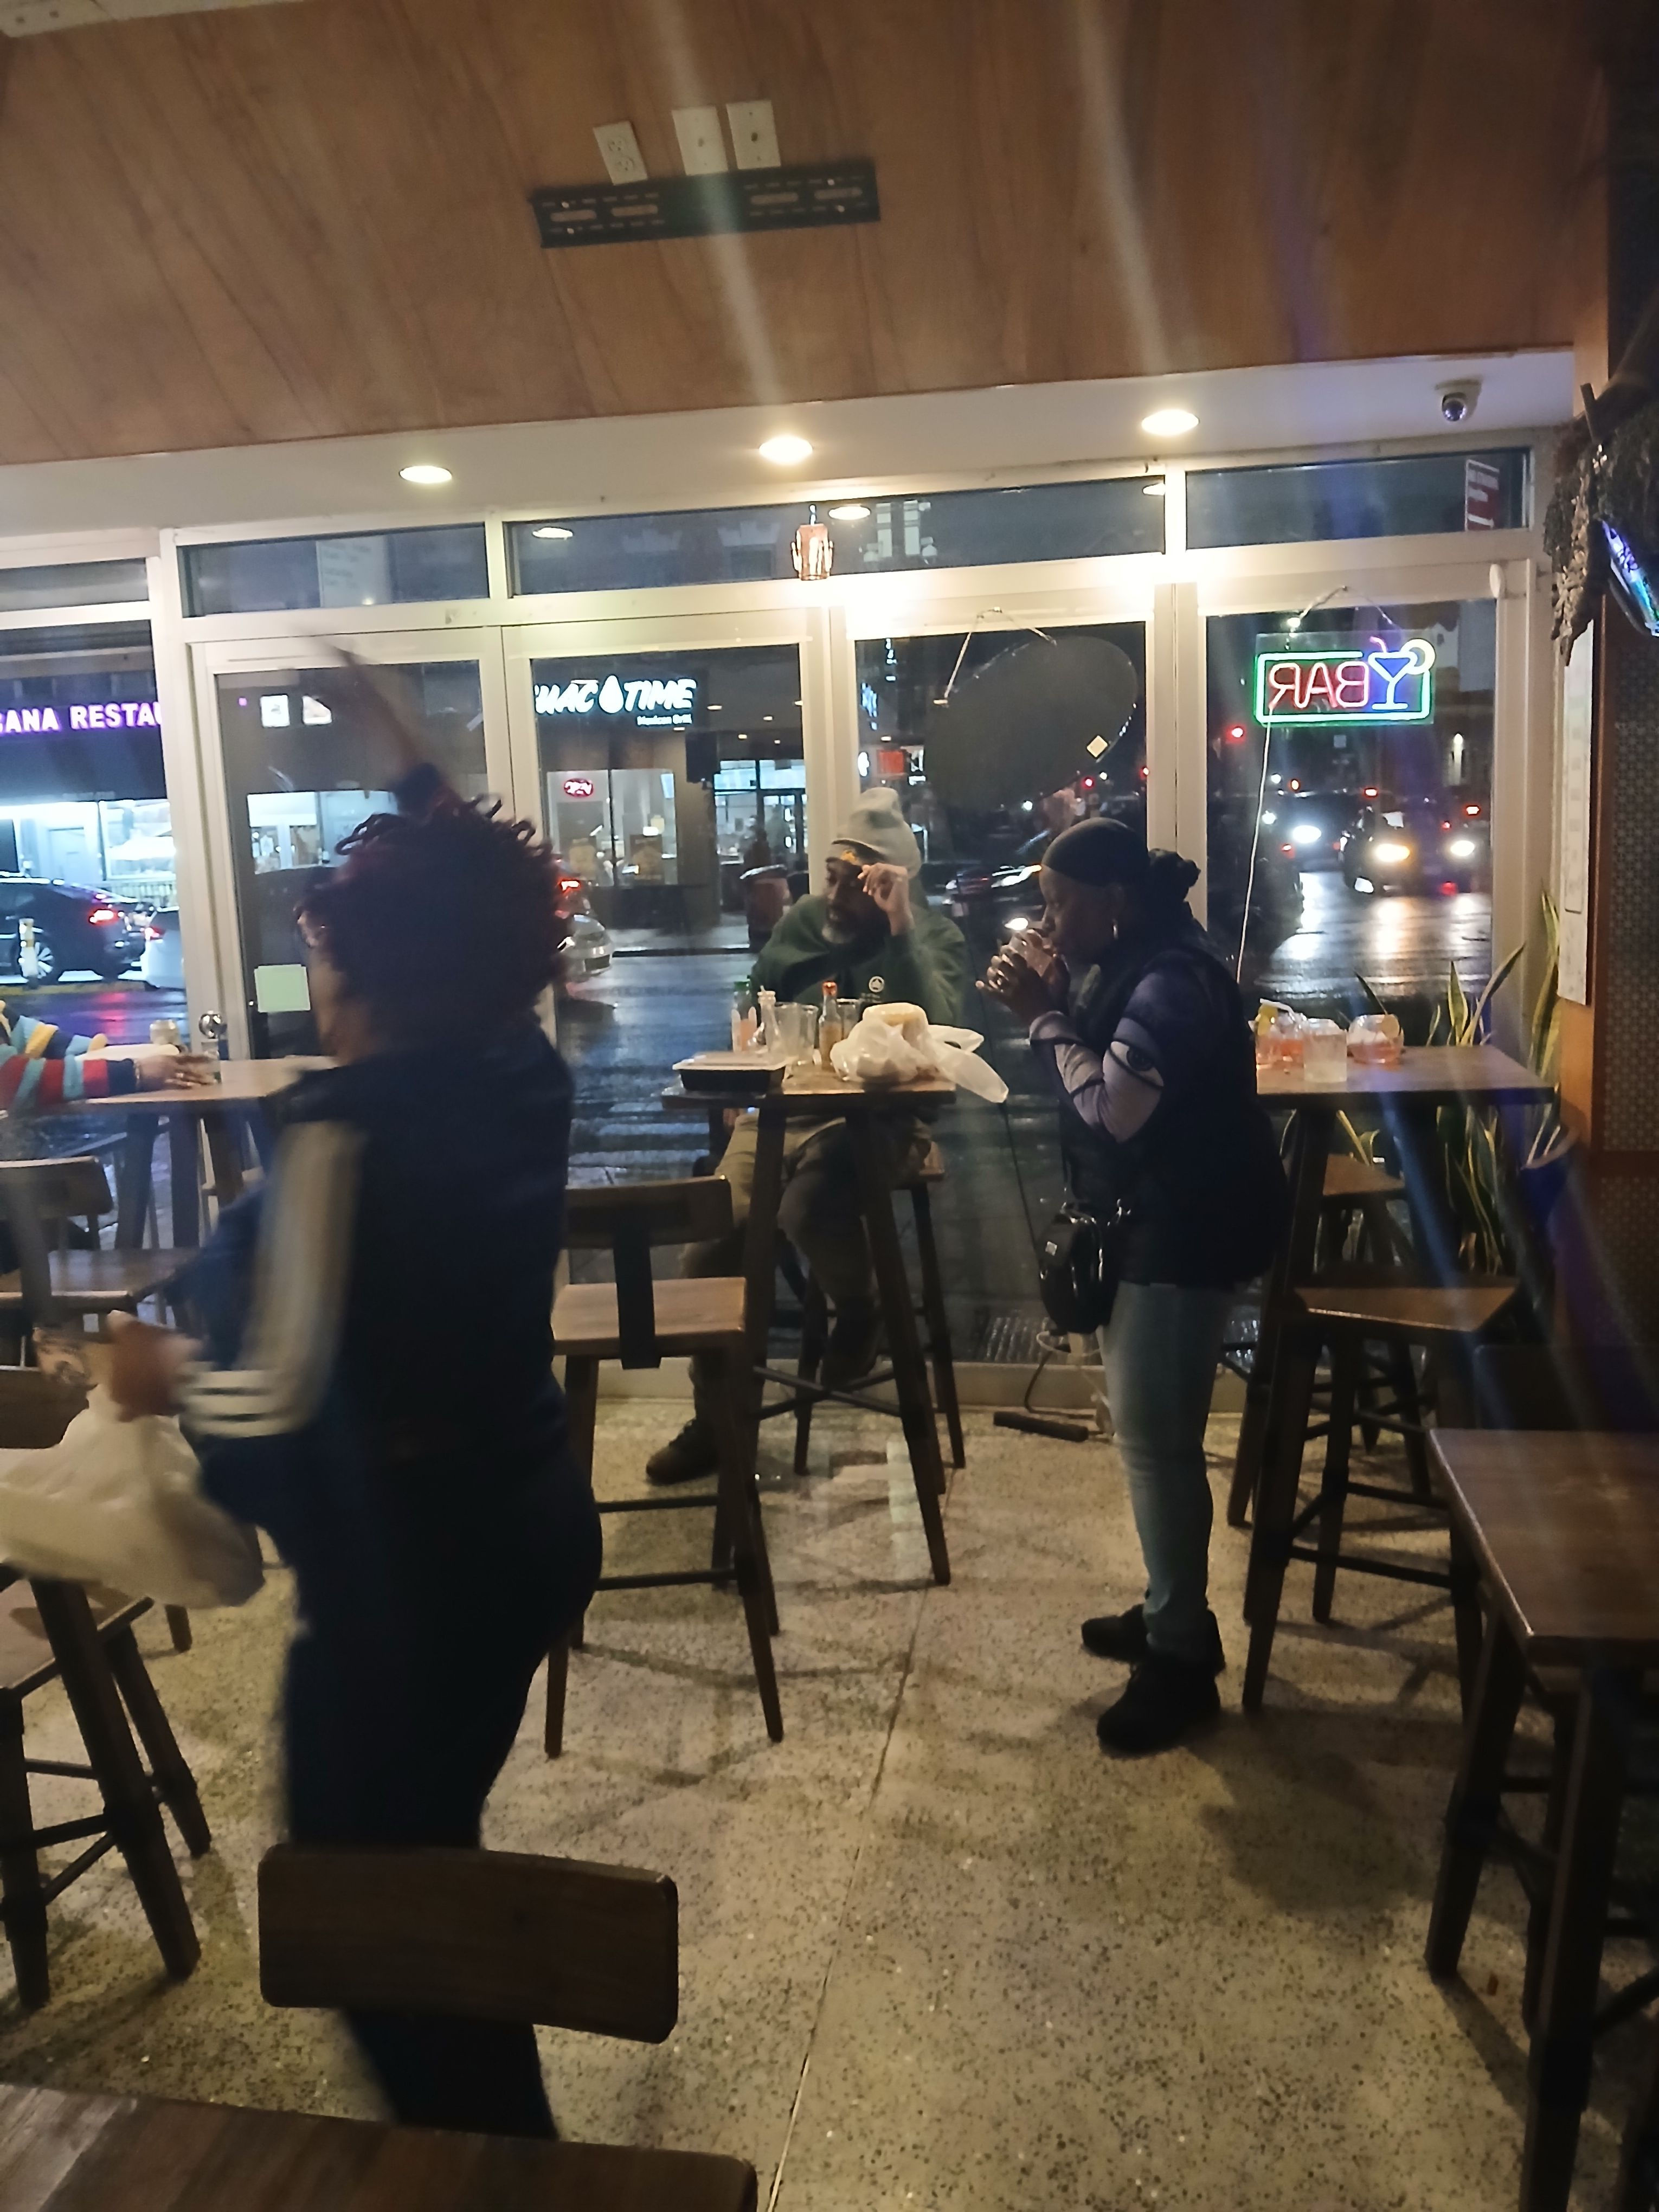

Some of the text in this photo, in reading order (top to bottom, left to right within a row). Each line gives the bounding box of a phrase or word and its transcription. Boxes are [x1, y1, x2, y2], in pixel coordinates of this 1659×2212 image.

[535, 678, 697, 715] UAC TIME
[0, 707, 59, 734] ANA
